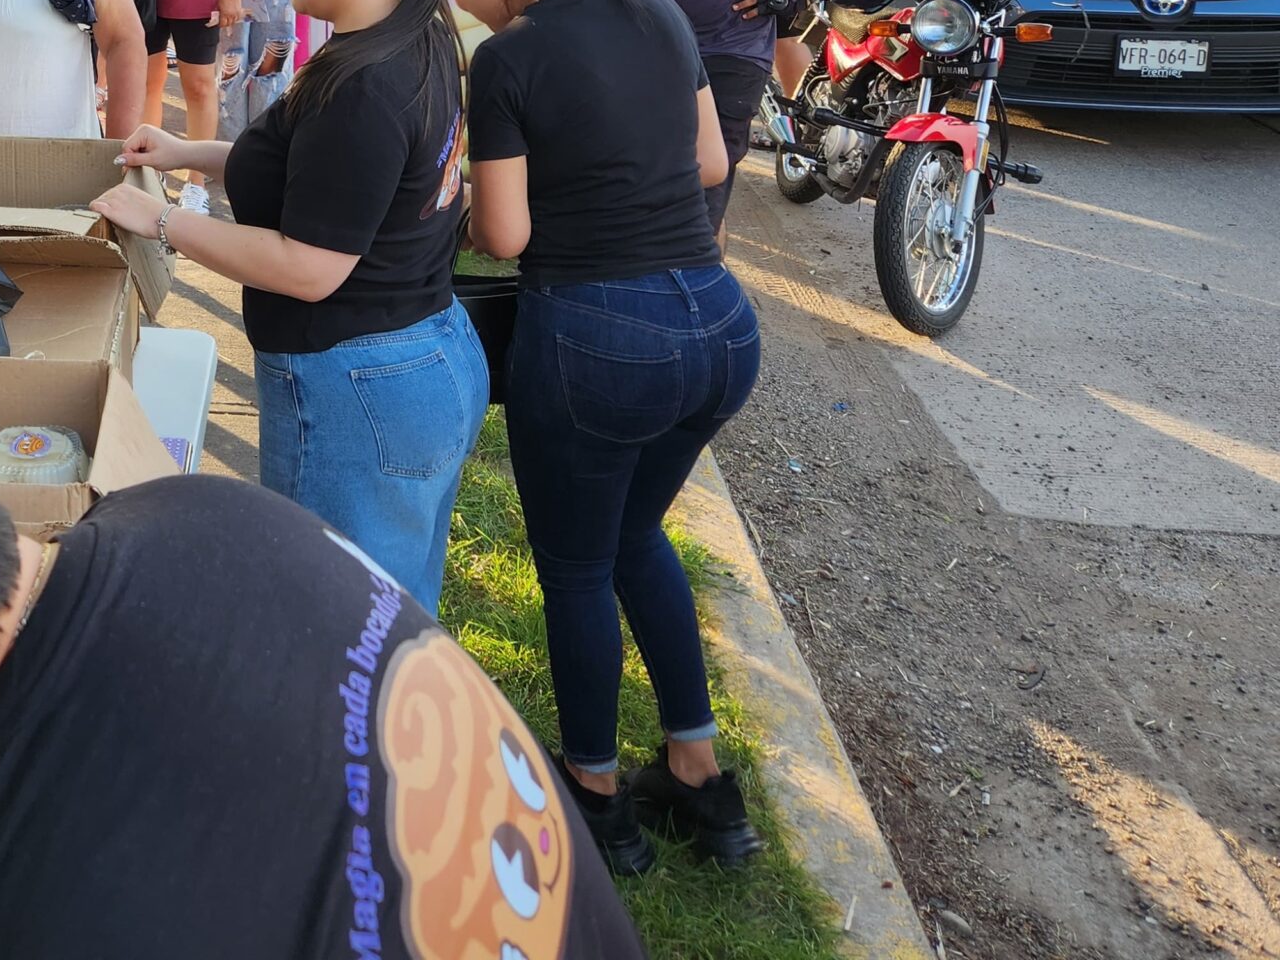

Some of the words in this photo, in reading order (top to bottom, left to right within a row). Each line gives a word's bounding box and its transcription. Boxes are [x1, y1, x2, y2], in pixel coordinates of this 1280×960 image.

[1119, 47, 1207, 67] VFR-064-D
[937, 66, 969, 75] YAMAHA
[1141, 65, 1183, 78] Premier
[338, 671, 372, 757] cada
[344, 762, 370, 817] en
